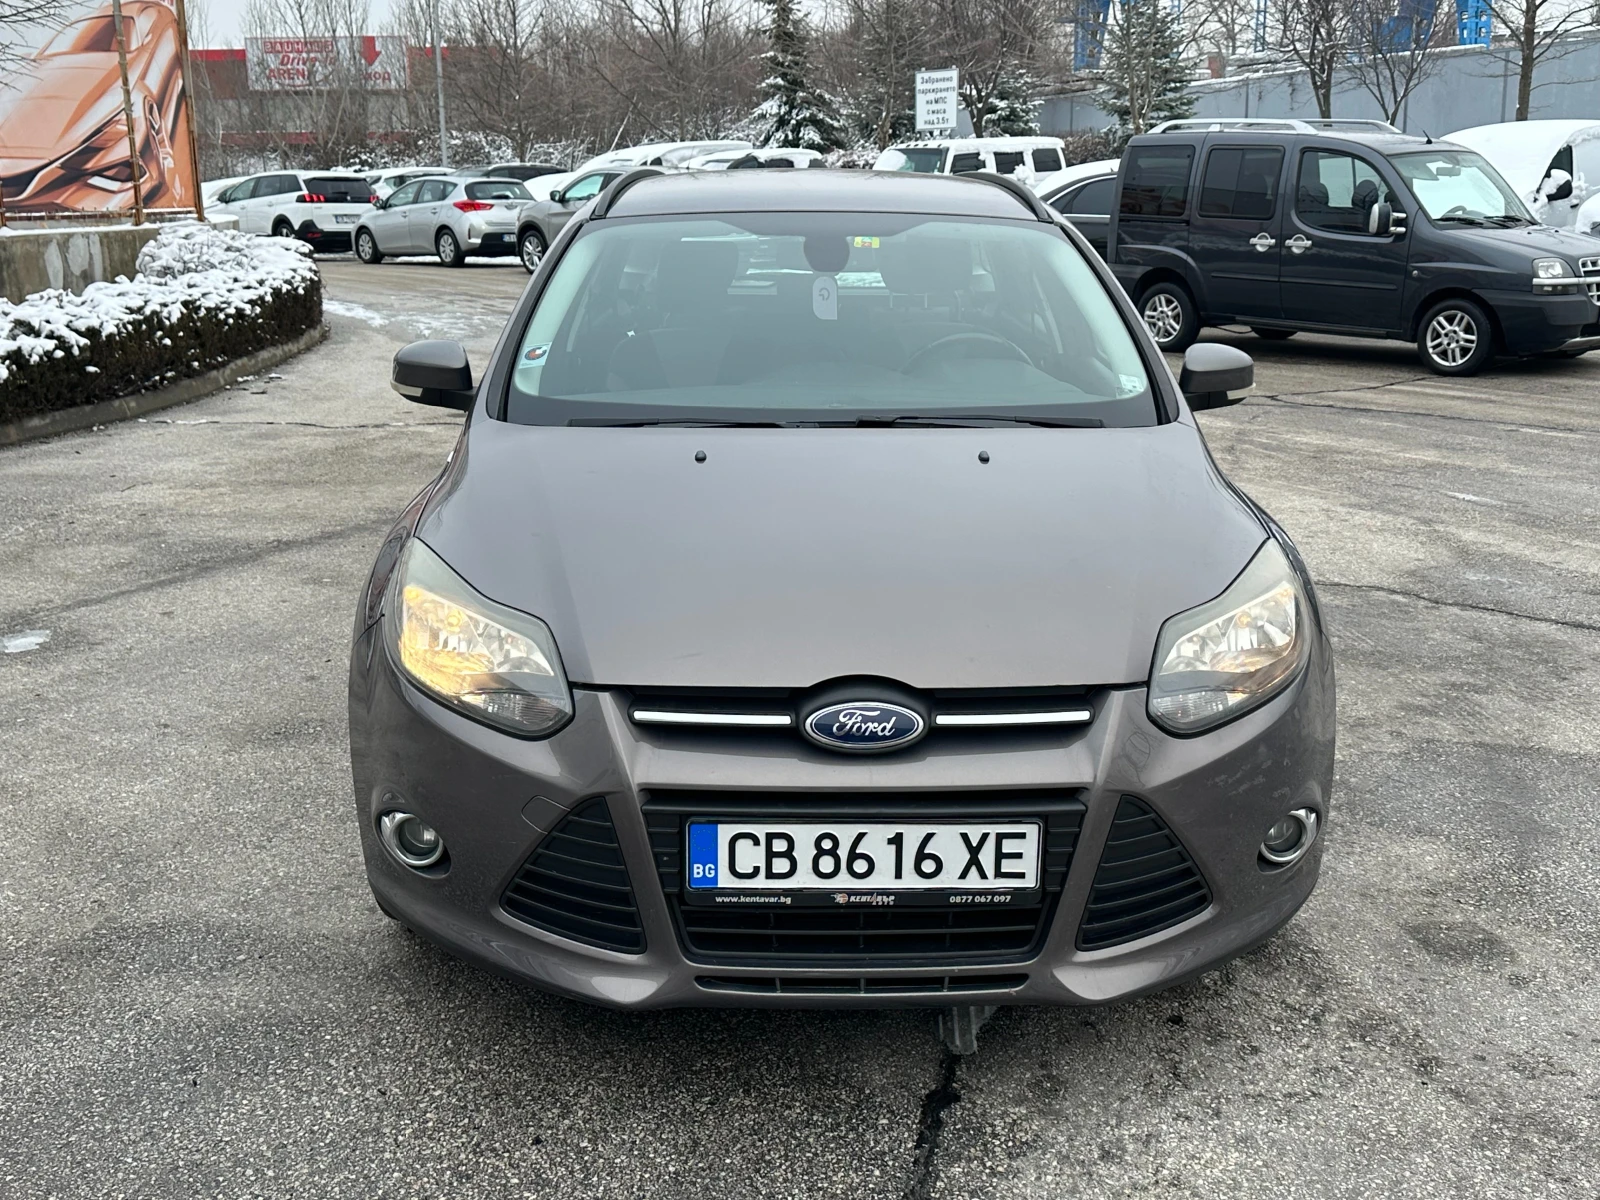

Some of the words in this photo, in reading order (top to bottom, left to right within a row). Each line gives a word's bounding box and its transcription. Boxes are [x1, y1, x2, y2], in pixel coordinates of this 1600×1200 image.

[264, 41, 333, 53] BAUHAUS
[267, 68, 313, 80] AREN
[920, 76, 953, 85] Забранено
[917, 86, 956, 95] паркирането
[934, 96, 947, 104] МПС
[832, 709, 896, 736] Ford
[727, 831, 798, 880] CB
[811, 831, 944, 880] 8616
[957, 831, 1027, 880] XE
[693, 864, 716, 878] BG
[715, 894, 791, 904] www.kentavar.bg
[949, 895, 972, 903] 0877
[974, 895, 992, 903] 067
[993, 895, 1011, 903] 097
